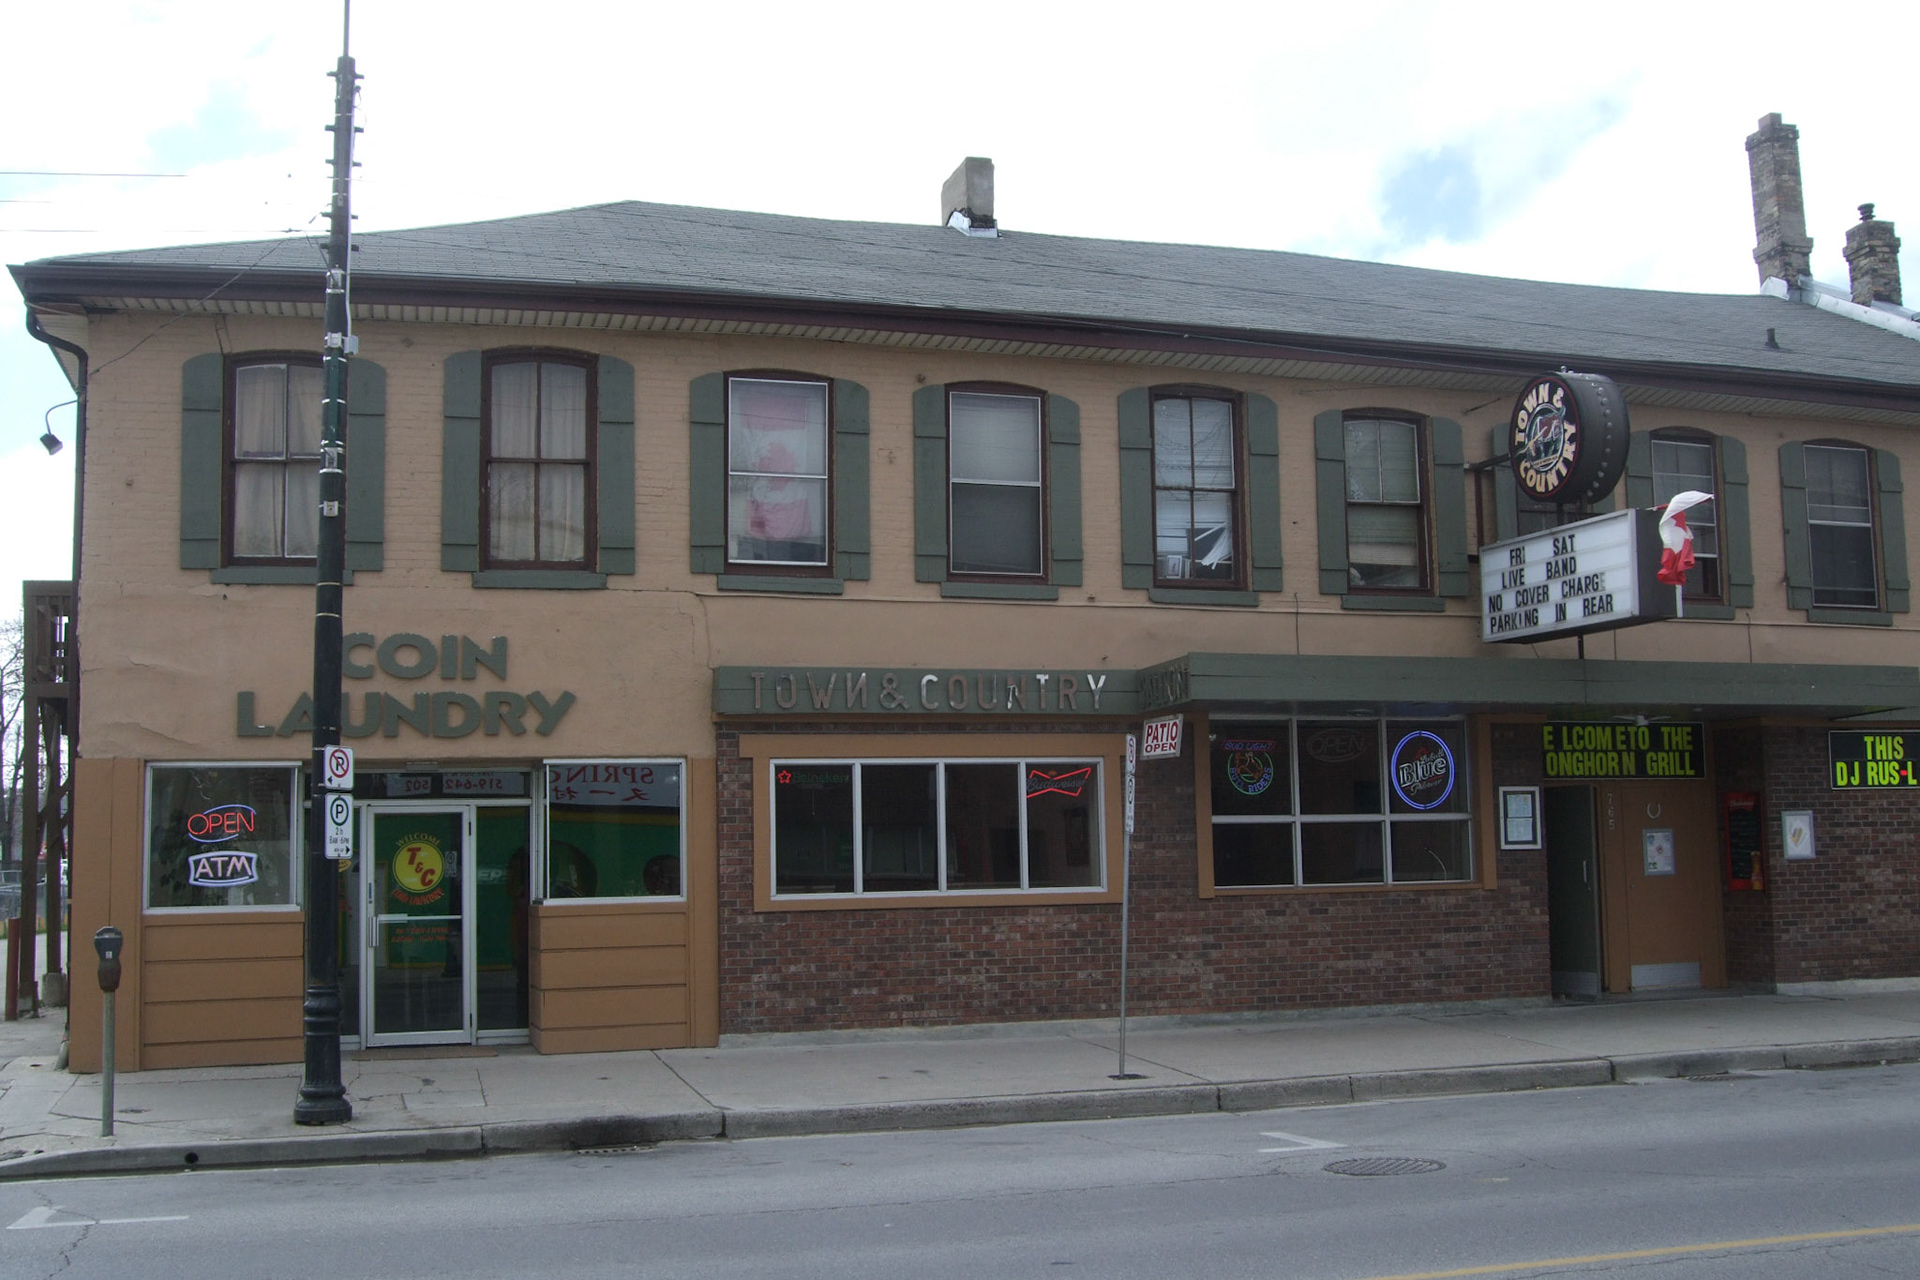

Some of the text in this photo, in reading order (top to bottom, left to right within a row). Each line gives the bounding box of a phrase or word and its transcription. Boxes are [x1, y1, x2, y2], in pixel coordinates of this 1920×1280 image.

[1515, 382, 1564, 446] TOWN &
[1520, 420, 1576, 492] COUNTRY
[1509, 533, 1576, 566] FRI SAT
[1501, 556, 1577, 589] LIVE BAND
[1488, 572, 1606, 614] NO COVER CHARGE
[1490, 593, 1614, 634] PARKING IN REAR
[342, 632, 509, 680] COIN
[751, 671, 868, 710] TOWN
[879, 672, 909, 710] &
[920, 673, 1106, 711] COUNTRY
[237, 690, 576, 738] LAUNDRY
[1145, 720, 1179, 744] PATIO
[1145, 741, 1177, 753] OPEN
[1661, 727, 1694, 752] THE
[1864, 736, 1904, 761] THIS
[1399, 758, 1447, 788] Blue
[1645, 752, 1696, 777] GRILL
[1248, 767, 1272, 793] RIDERS
[187, 811, 255, 835] OPEN
[395, 833, 441, 848] WELCOME
[195, 856, 252, 879] ATM
